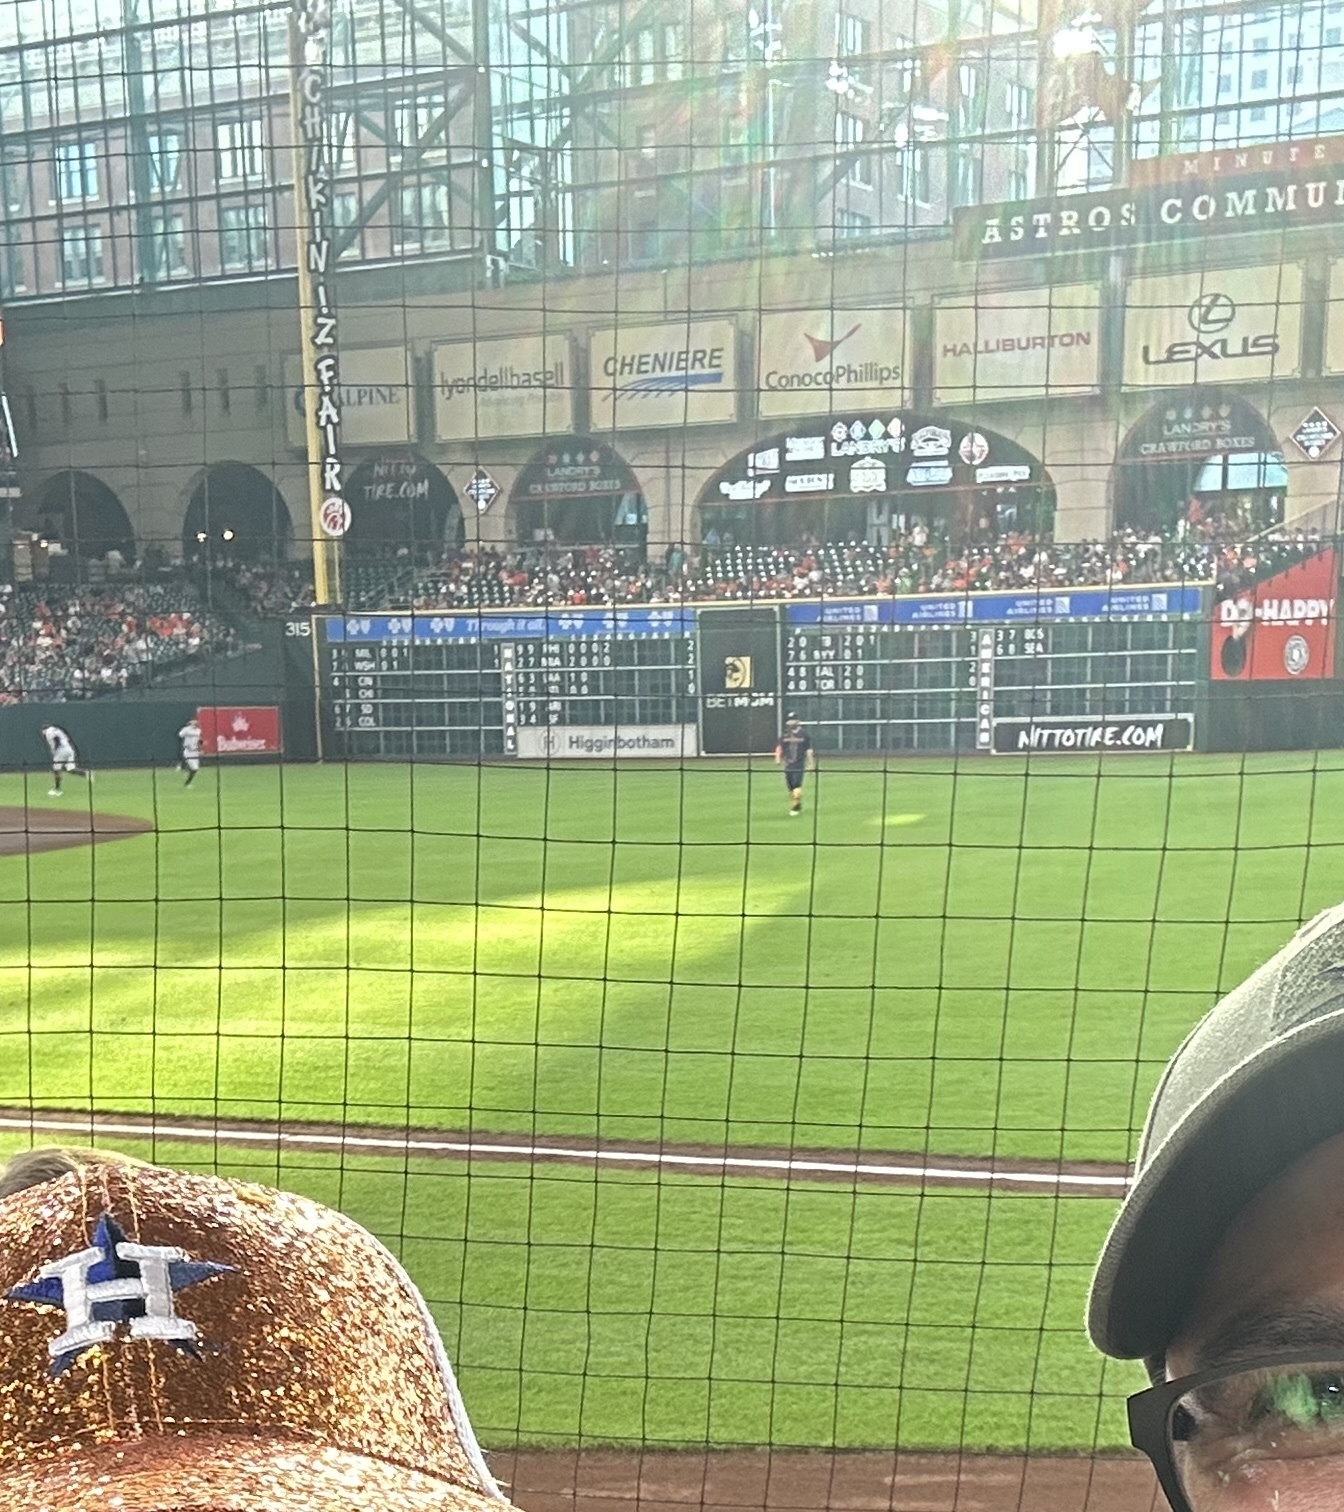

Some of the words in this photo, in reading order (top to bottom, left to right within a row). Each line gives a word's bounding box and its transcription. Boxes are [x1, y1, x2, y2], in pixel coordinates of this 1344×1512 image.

[1183, 144, 1326, 175] MINUTE
[981, 202, 1136, 245] ASTROS
[943, 331, 1092, 358] HALLIBURTON
[1142, 334, 1280, 365] LEXUS
[603, 347, 725, 377] CHENIERE
[765, 361, 901, 390] ConocoPhillips
[317, 358, 342, 492] FAIR
[285, 622, 311, 636] 315
[568, 735, 675, 753] Higginbotham
[1018, 723, 1164, 749] NITTOTIRE.COM
